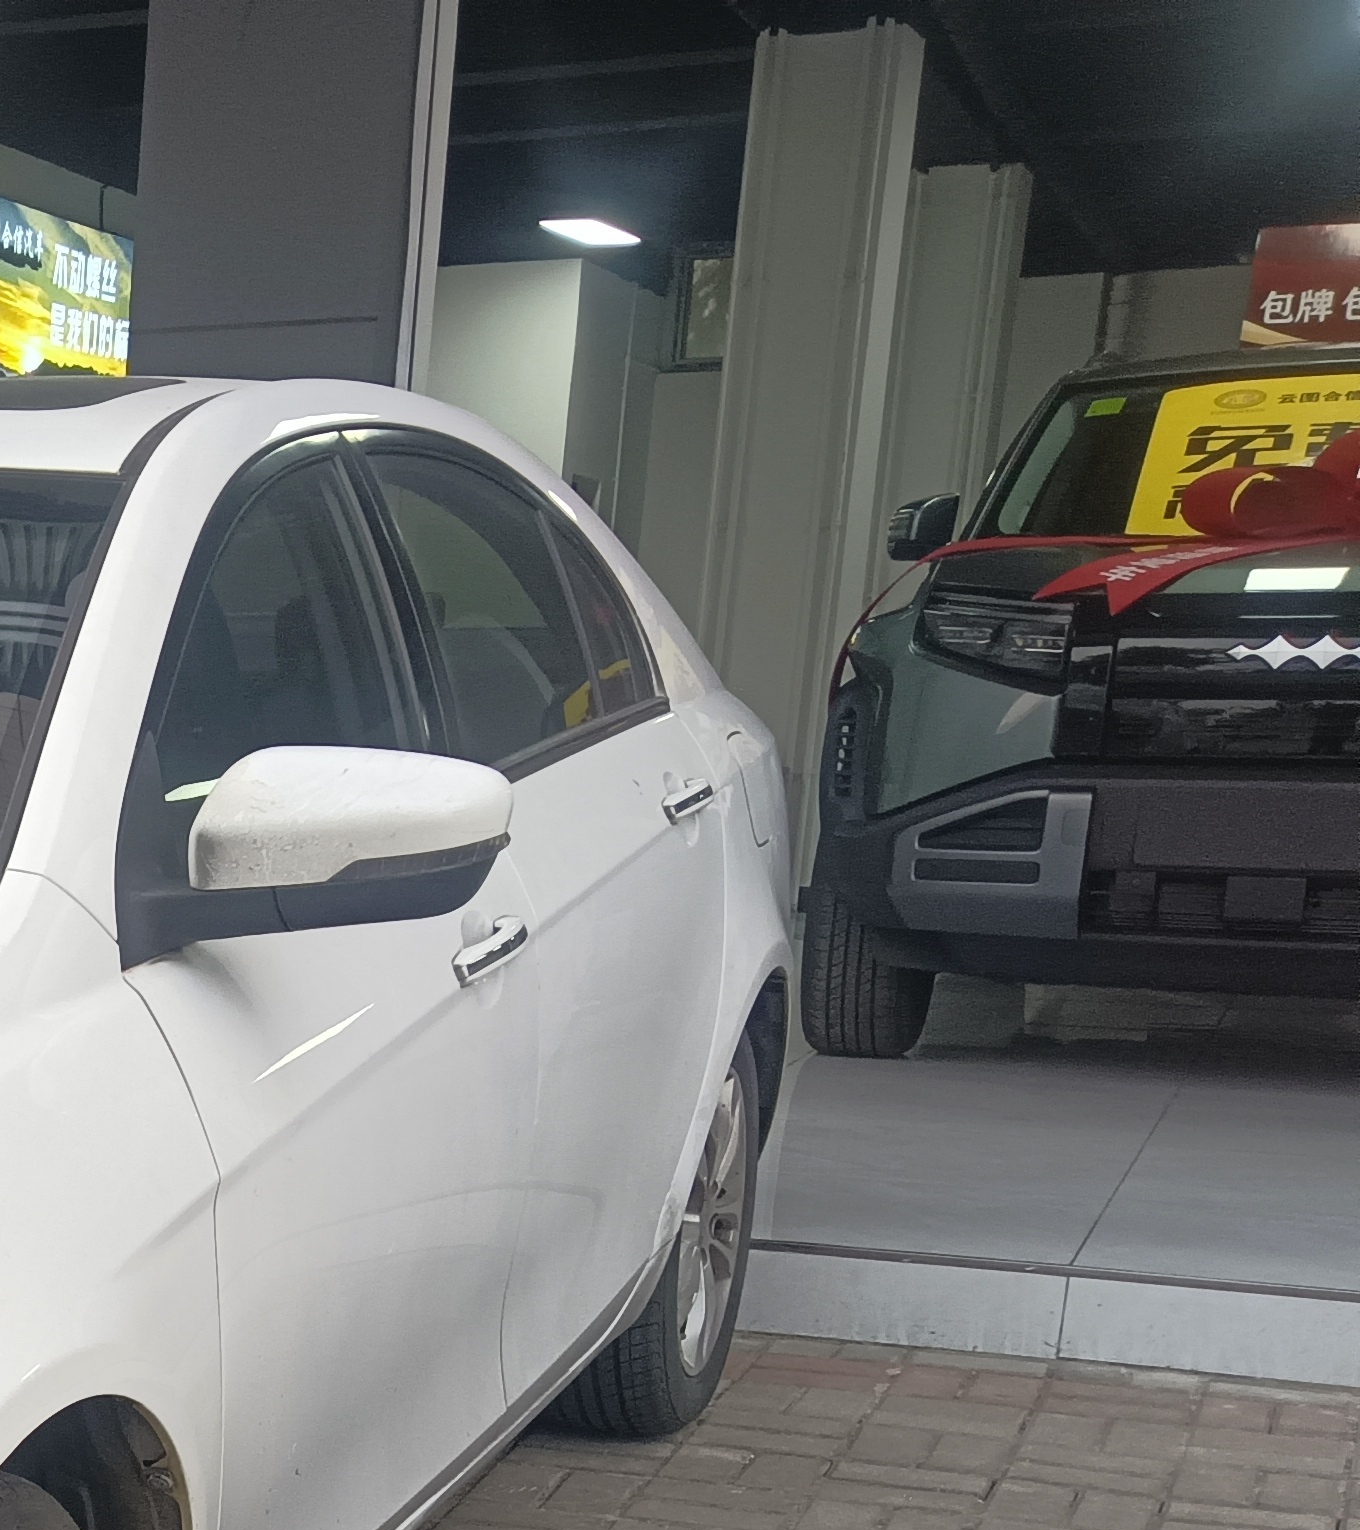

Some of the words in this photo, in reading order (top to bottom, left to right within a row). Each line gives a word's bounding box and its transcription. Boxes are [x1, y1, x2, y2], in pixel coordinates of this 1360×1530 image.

[52, 243, 118, 303] 不动螺丝
[1260, 288, 1335, 324] 包牌
